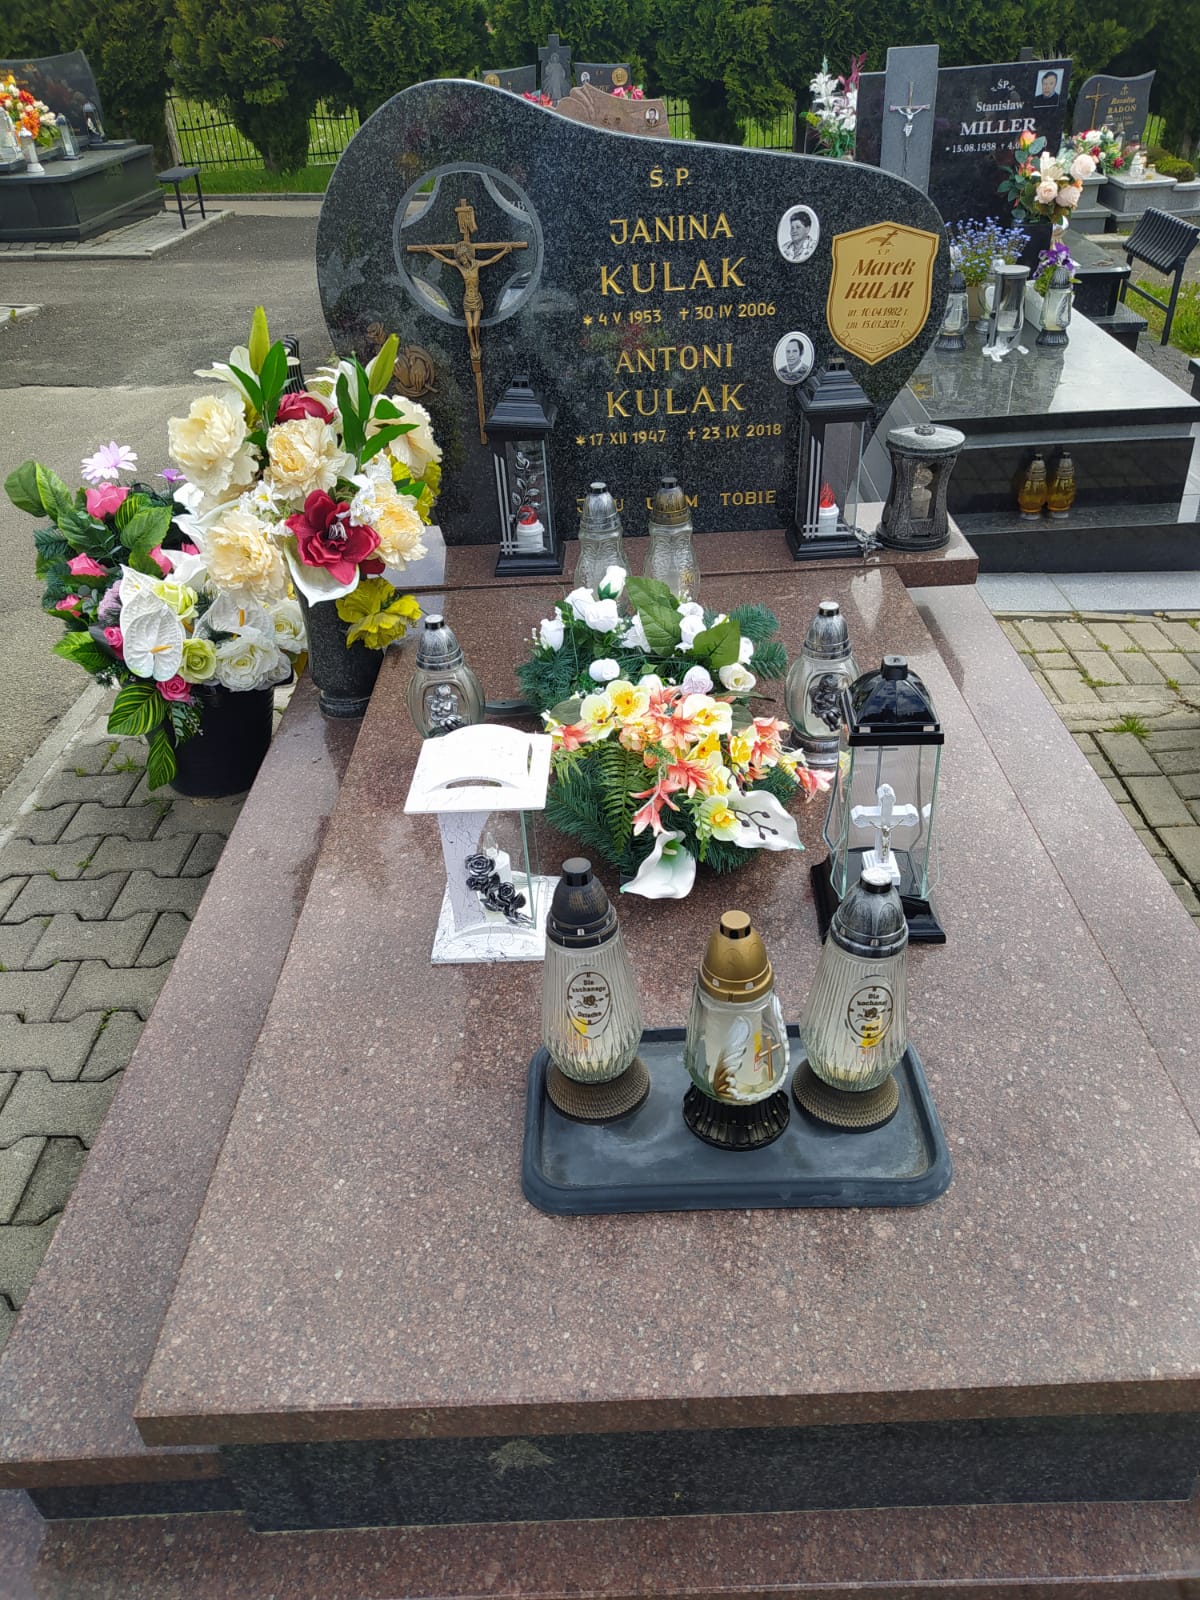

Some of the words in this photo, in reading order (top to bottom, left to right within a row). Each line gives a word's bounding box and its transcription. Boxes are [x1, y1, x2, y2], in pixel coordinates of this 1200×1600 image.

[976, 99, 1024, 113] Stanisław
[960, 118, 1036, 136] MILLER
[609, 212, 735, 246] JANINA
[600, 256, 747, 296] KULAK
[852, 259, 916, 276] Marek
[845, 282, 914, 299] KULAK
[598, 312, 608, 326] 4
[612, 312, 622, 325] V
[628, 309, 662, 324] 1953
[695, 305, 714, 320] 30
[719, 304, 734, 318] IV
[738, 302, 776, 318] 2006
[615, 343, 733, 374] ANTONI
[606, 384, 746, 419] KULAK
[590, 434, 604, 446] 17
[610, 431, 627, 445] XII
[632, 429, 667, 445] 1947
[702, 426, 721, 440] 23
[726, 424, 740, 438] IX
[746, 423, 782, 438] 2018
[720, 490, 777, 506] TOBIE
